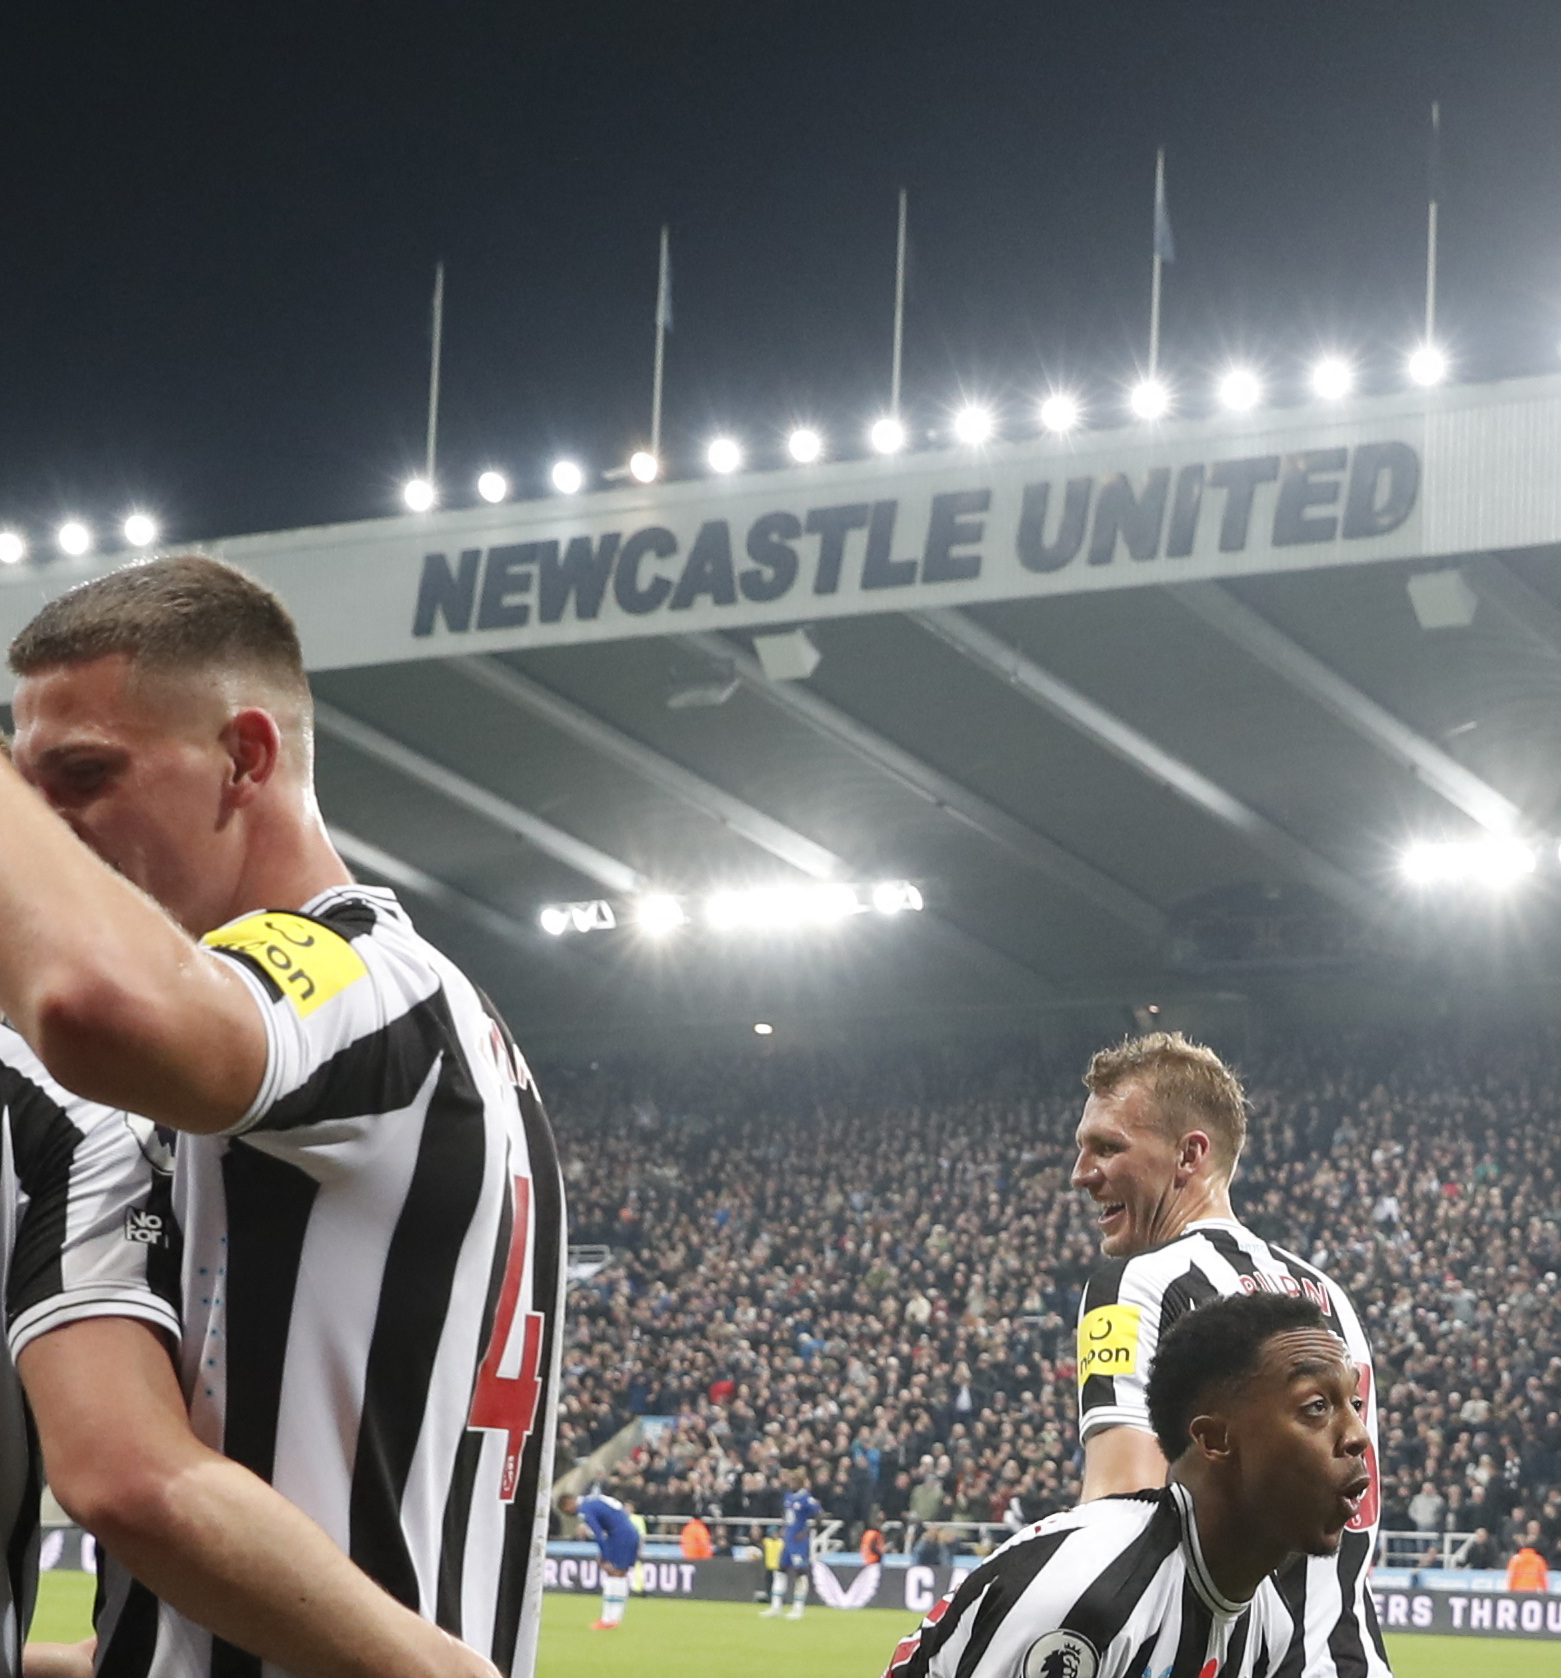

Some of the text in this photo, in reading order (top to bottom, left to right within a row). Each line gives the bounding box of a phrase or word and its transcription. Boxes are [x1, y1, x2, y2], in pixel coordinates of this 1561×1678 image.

[412, 439, 1422, 638] NEWCASTLE UNITED
[126, 1205, 163, 1230] No
[468, 1174, 544, 1503] 4
[544, 1558, 696, 1593] ROUOUT
[1373, 1595, 1433, 1628] ERS
